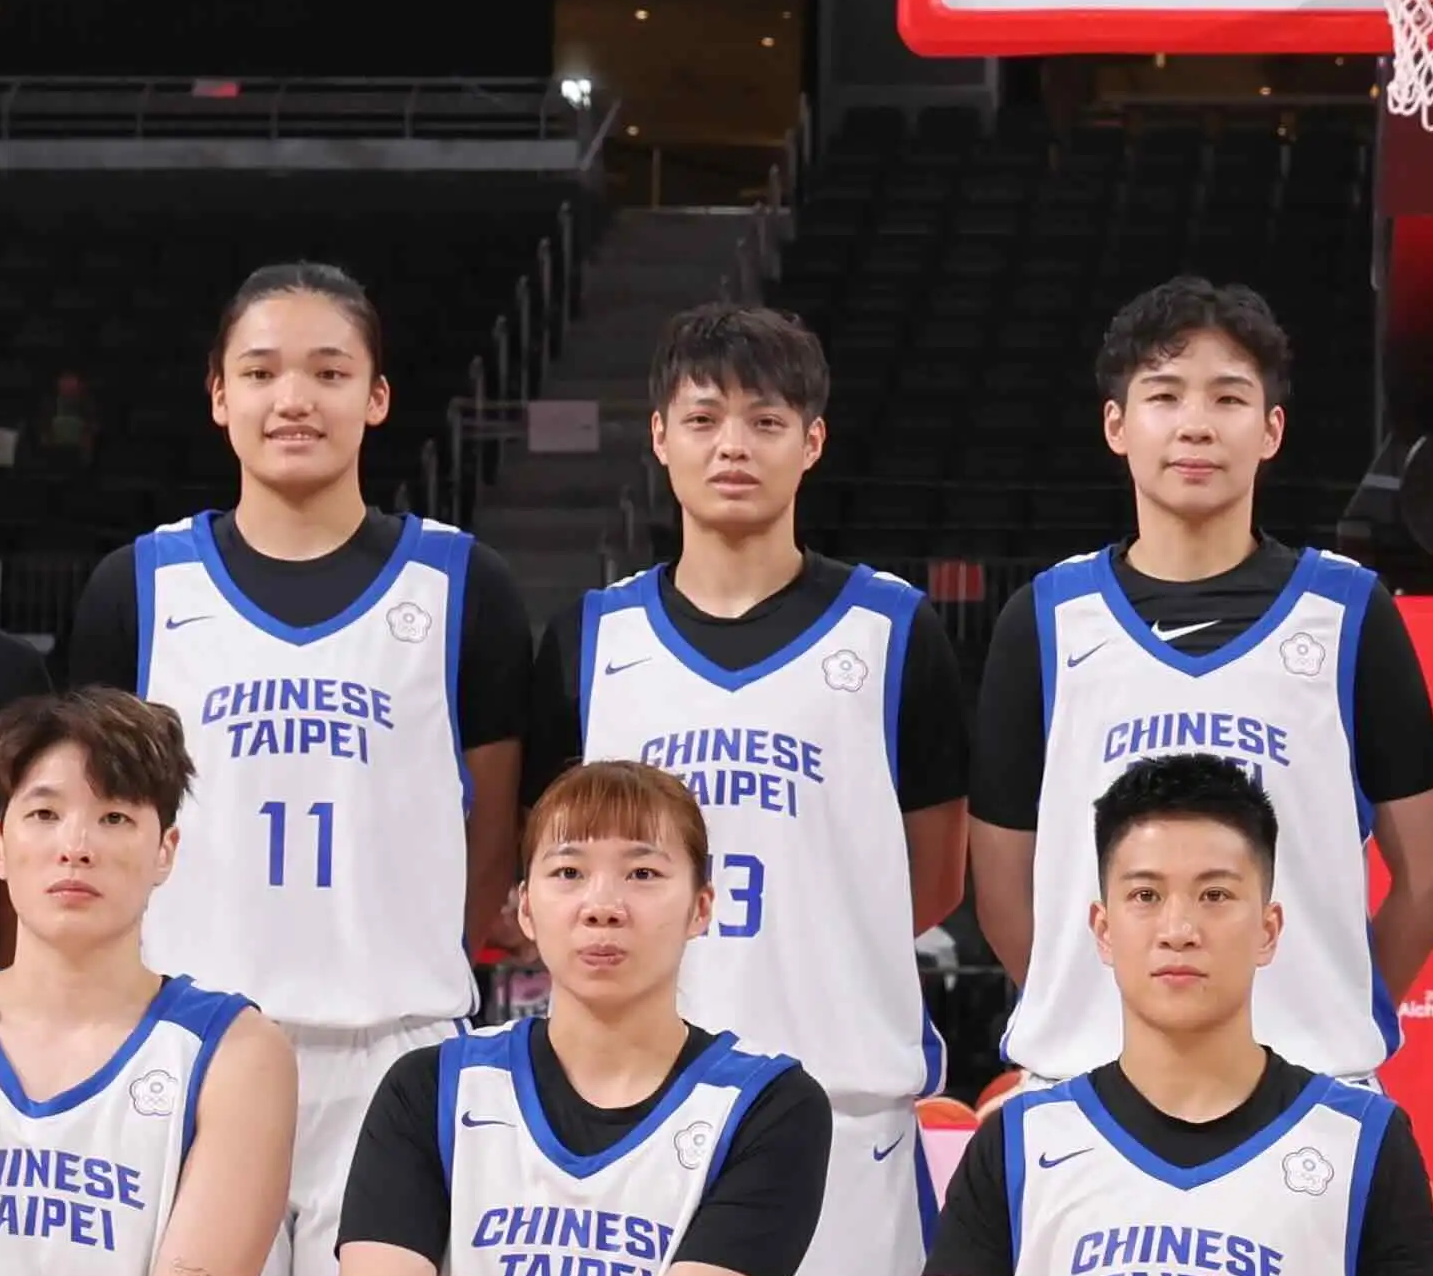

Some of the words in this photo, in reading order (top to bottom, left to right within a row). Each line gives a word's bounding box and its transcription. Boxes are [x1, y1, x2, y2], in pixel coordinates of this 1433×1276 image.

[201, 678, 394, 730] CHINESE
[227, 719, 369, 765] TAIPEI
[640, 728, 825, 784] CHINESE
[1103, 712, 1291, 767] CHINESE
[676, 769, 798, 819] AIPEI
[259, 801, 335, 888] 11
[705, 854, 765, 938] 3
